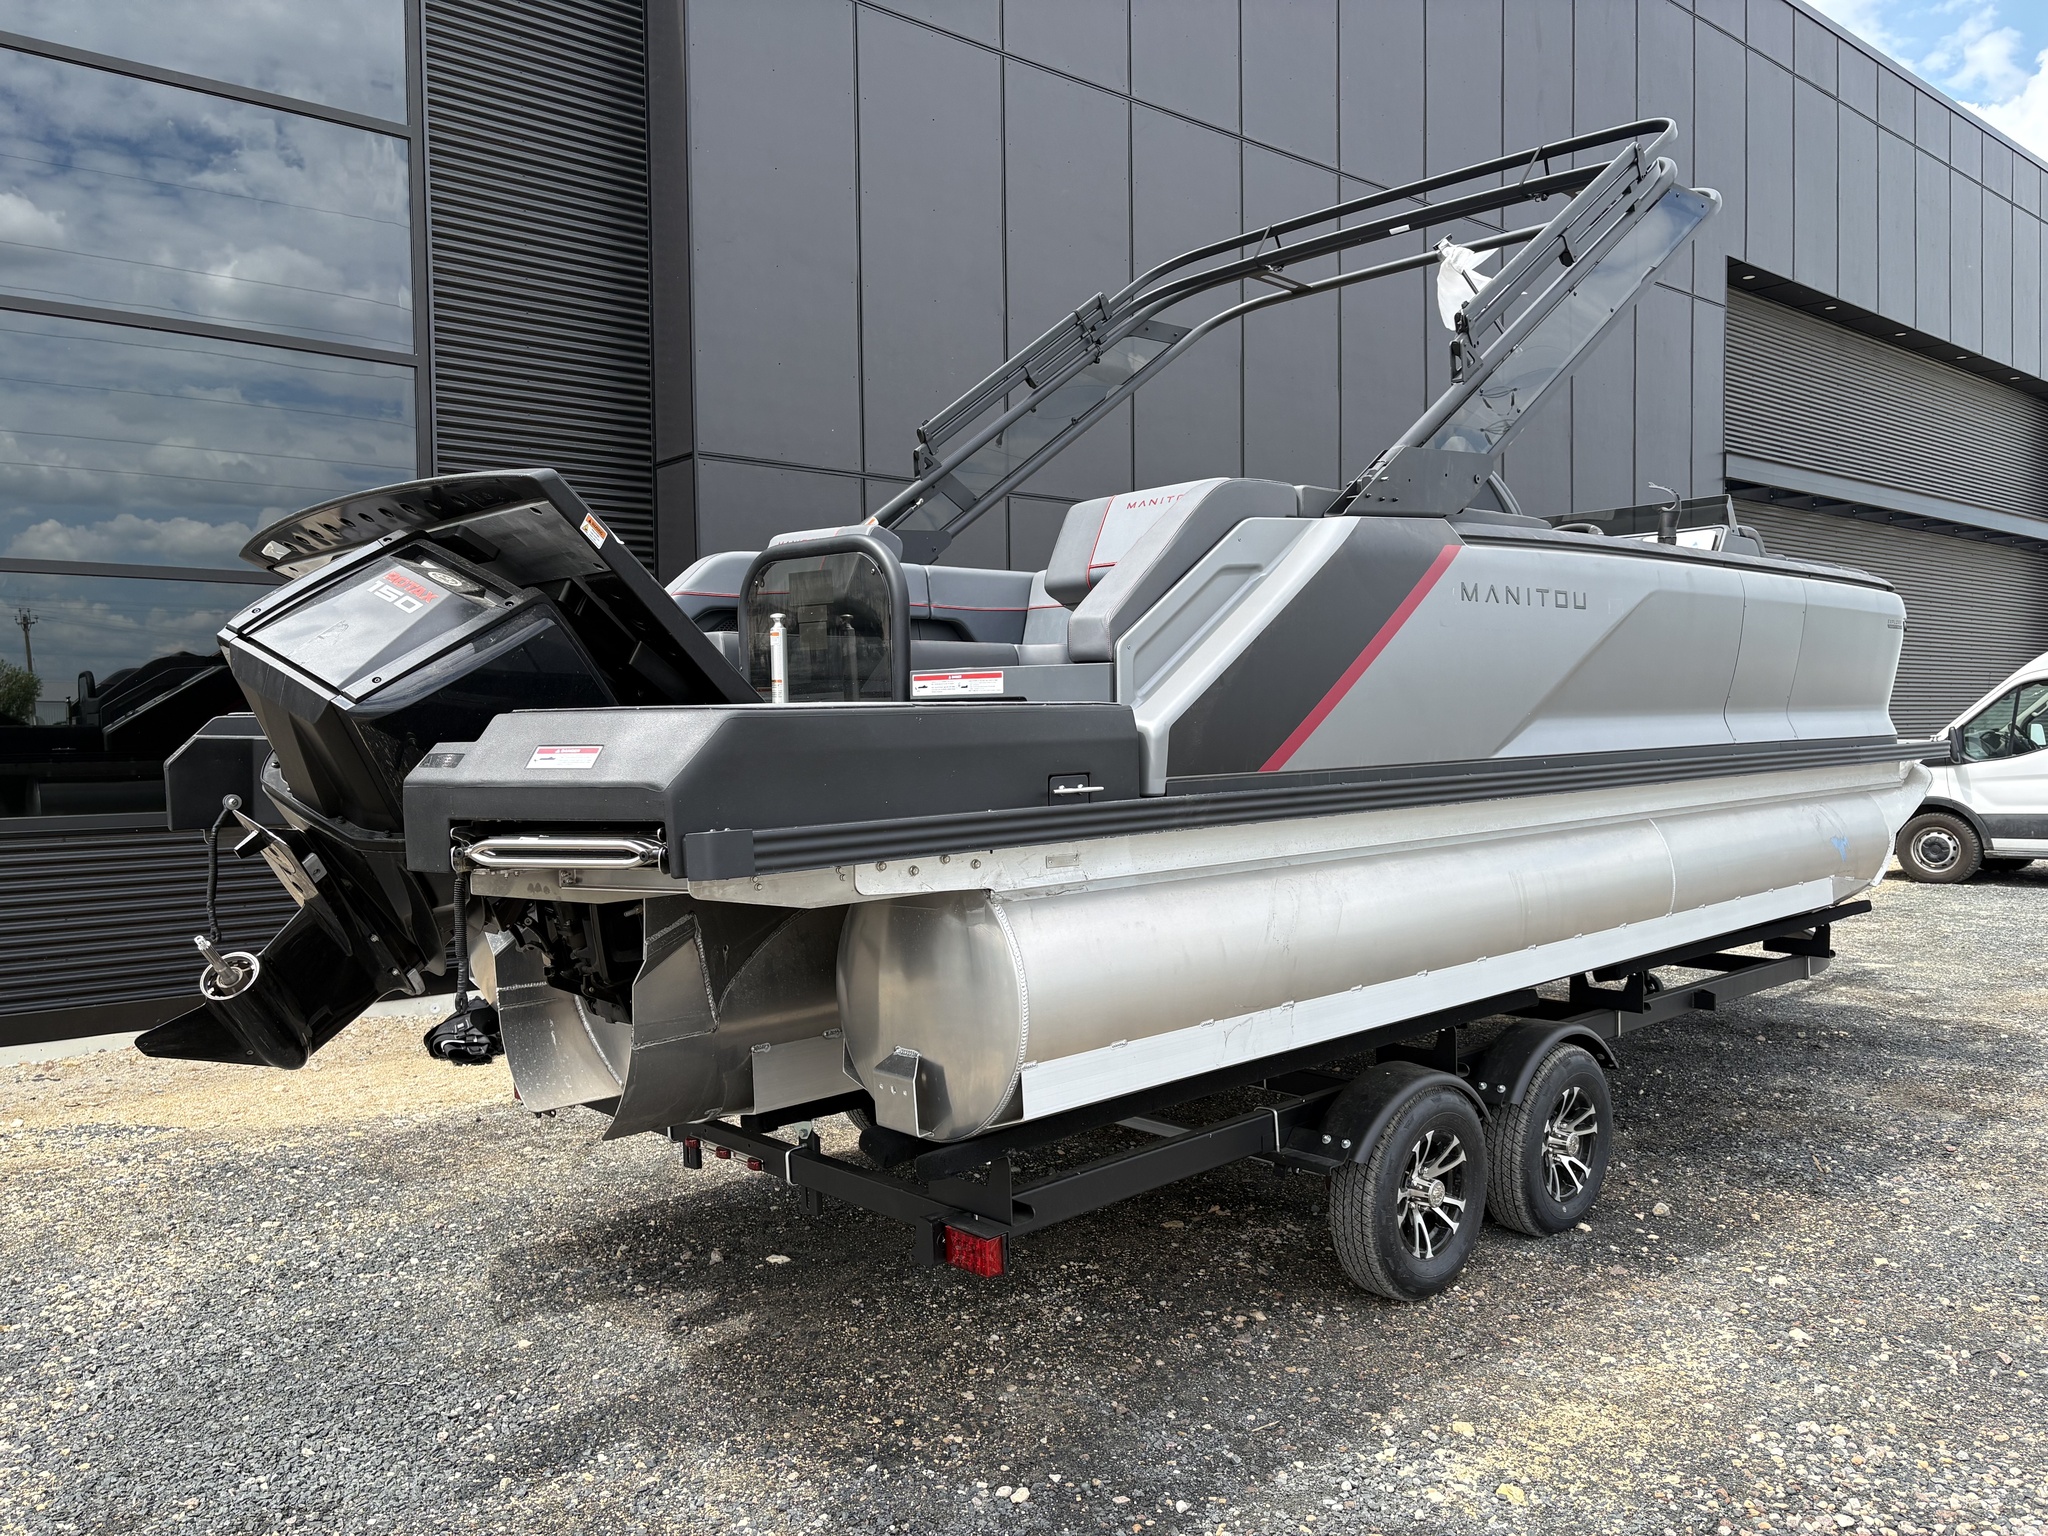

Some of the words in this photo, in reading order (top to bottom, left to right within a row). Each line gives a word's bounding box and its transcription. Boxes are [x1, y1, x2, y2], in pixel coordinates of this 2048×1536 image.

[1126, 494, 1185, 510] MANITO
[366, 580, 424, 614] 150
[383, 570, 439, 604] ROTAX
[1460, 581, 1587, 610] MANITOU
